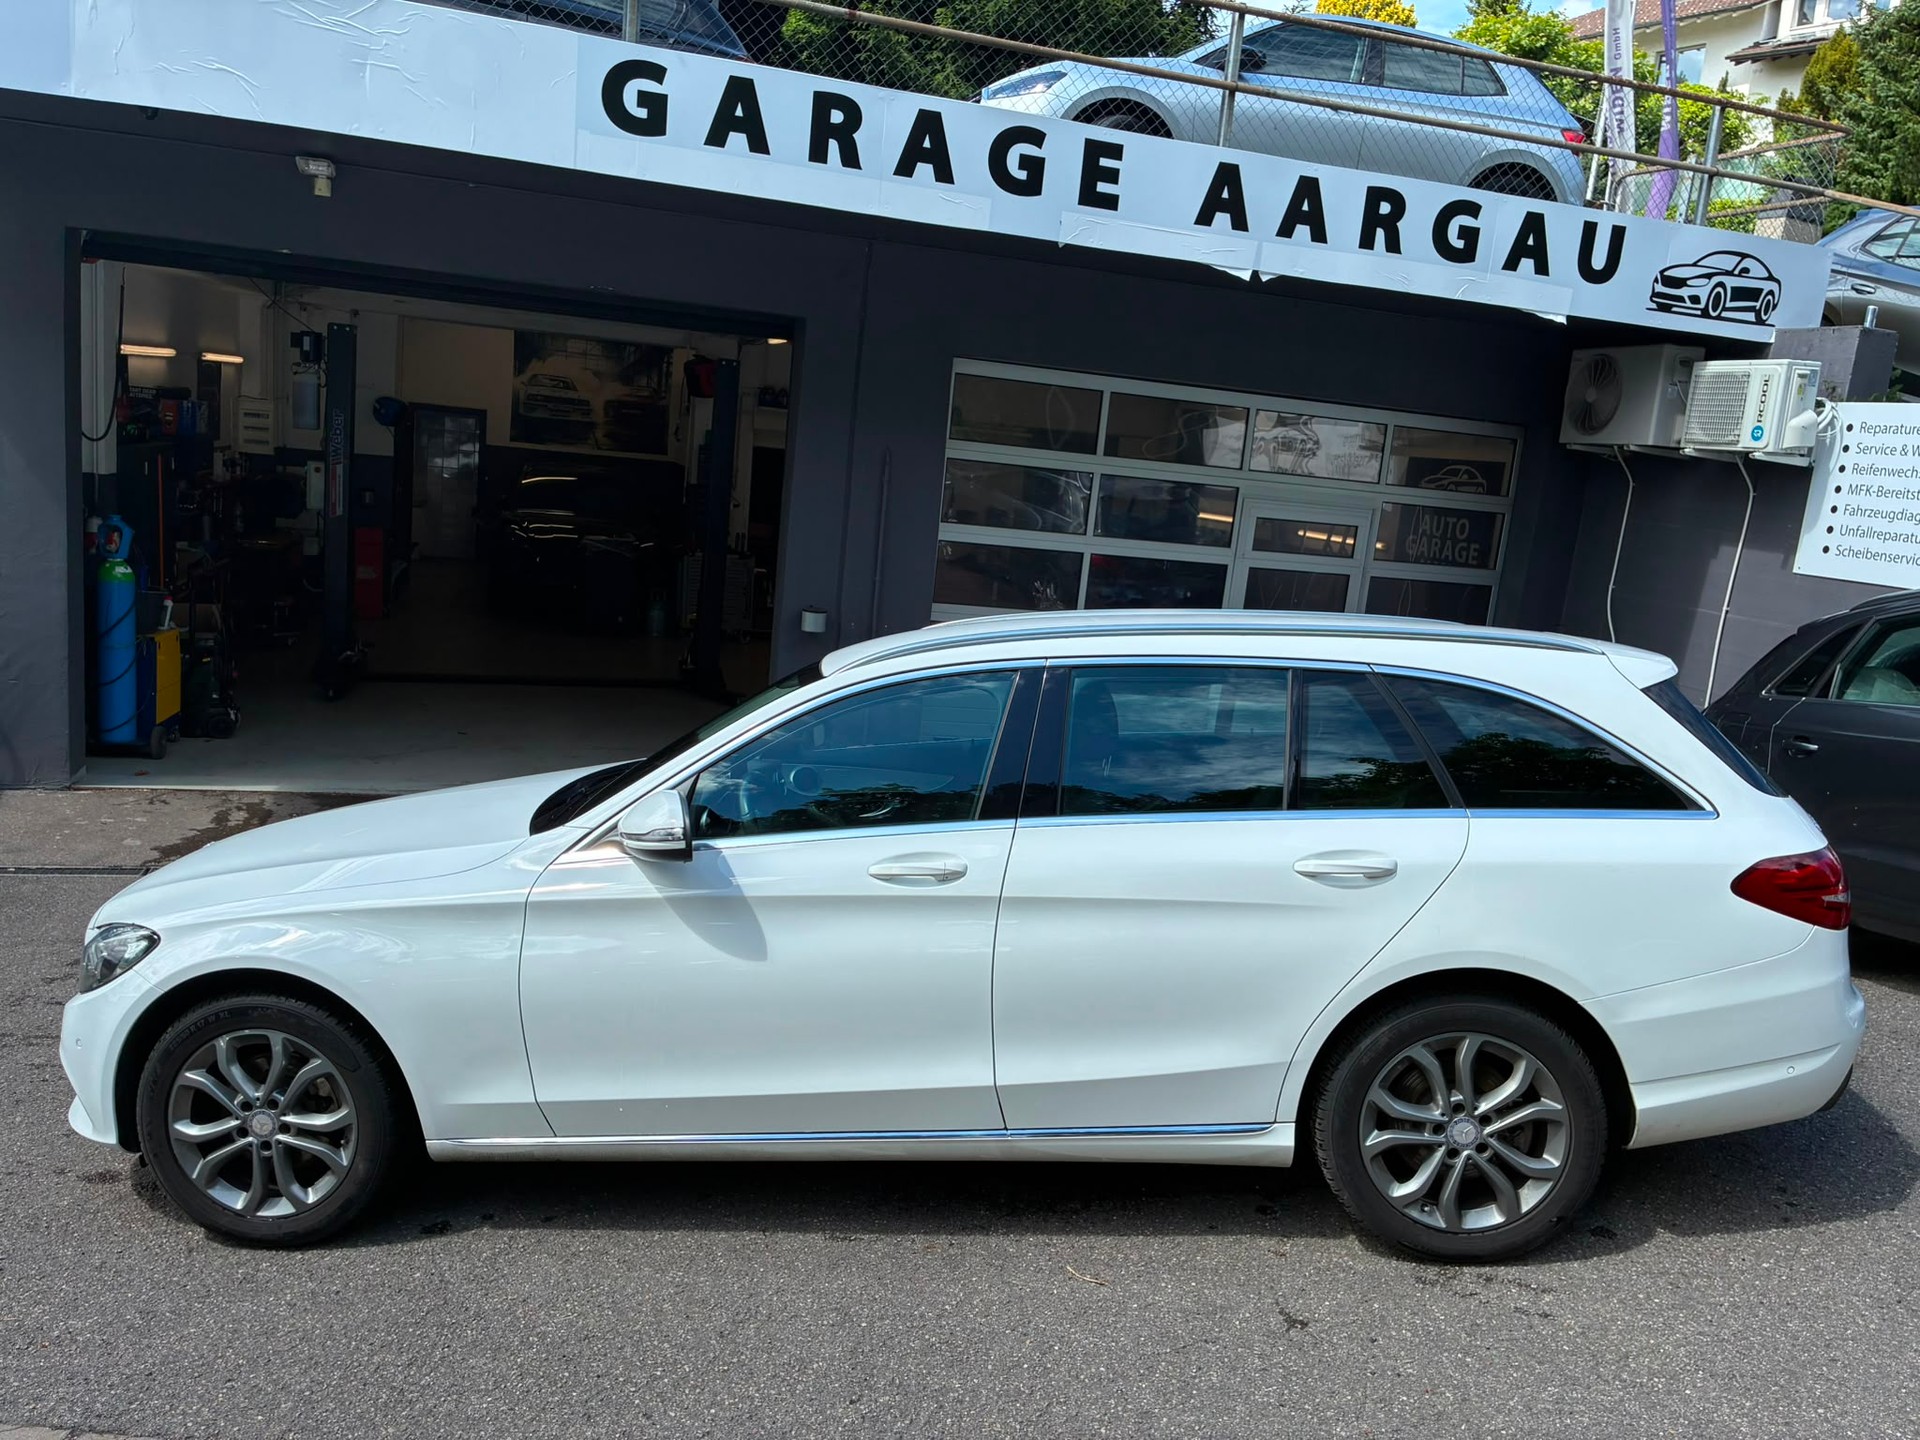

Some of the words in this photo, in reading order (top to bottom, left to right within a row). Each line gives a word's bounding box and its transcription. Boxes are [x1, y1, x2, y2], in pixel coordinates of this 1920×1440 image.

[1612, 27, 1622, 60] GmbH
[600, 58, 1125, 212] GARAGE
[1193, 161, 1628, 285] AARGAU
[329, 408, 344, 458] Weber
[1855, 442, 1897, 456] Service
[1899, 443, 1909, 457] &
[1851, 462, 1920, 479] Reifenwech
[1421, 513, 1470, 540] AUTO
[1843, 504, 1920, 526] Fahrzeugdiag
[1405, 534, 1481, 564] GARAGE
[1835, 544, 1920, 567] Scheibenservic
